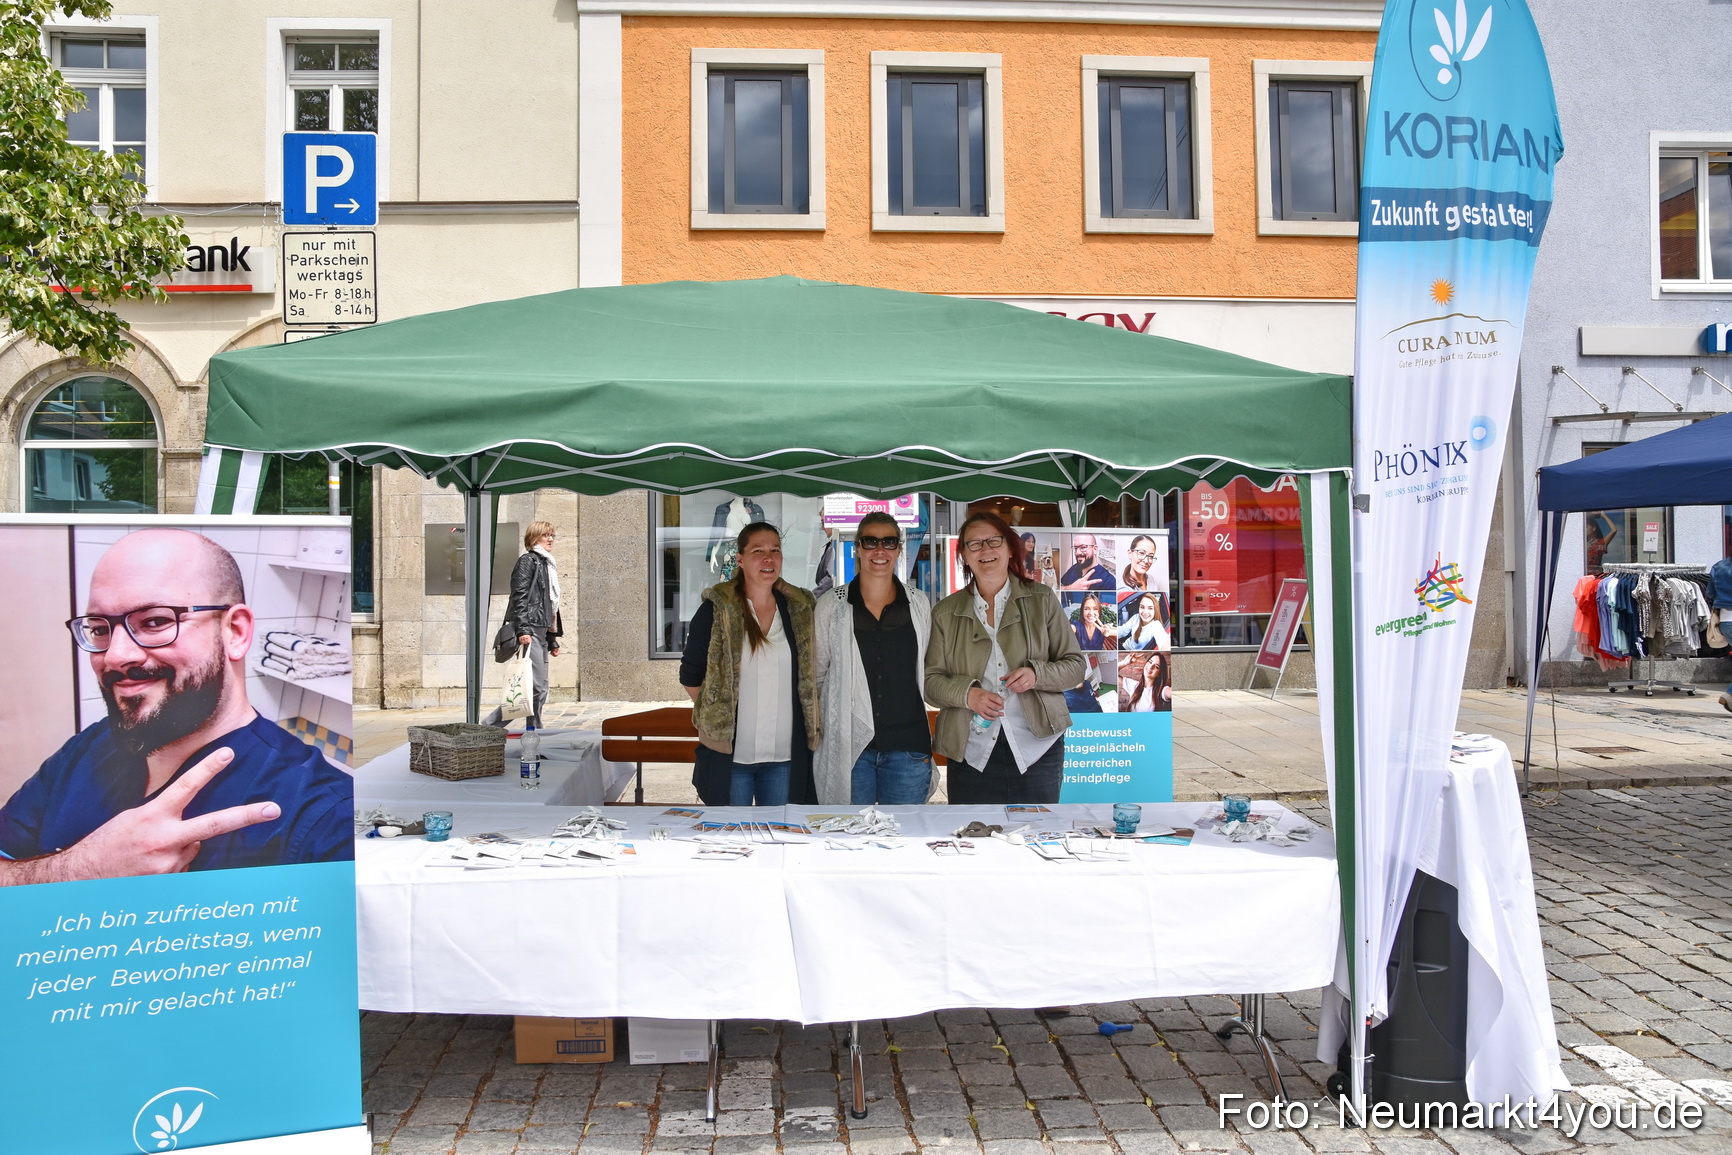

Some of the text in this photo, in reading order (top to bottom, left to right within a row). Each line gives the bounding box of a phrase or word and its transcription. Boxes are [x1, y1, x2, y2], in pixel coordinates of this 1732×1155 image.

[1384, 110, 1550, 175] KORIAN
[305, 145, 355, 214] P
[1371, 199, 1440, 226] Zukunft
[302, 238, 356, 251] nur mit
[290, 253, 369, 266] Parkschein
[297, 269, 363, 284] werktags
[289, 288, 328, 300] Mo-Fr
[290, 305, 305, 316] Sa
[1398, 330, 1499, 354] CURANUM
[1440, 352, 1455, 364] hat
[1374, 440, 1469, 482] PHÖNIX
[1192, 500, 1228, 520] -50
[1209, 591, 1231, 601] say
[1063, 727, 1133, 738] lbstbewusst
[1063, 742, 1146, 755] ntageinlächeln
[1062, 757, 1132, 768] eleerreichen
[1063, 773, 1131, 784] irsindpflege
[99, 909, 137, 929] bin
[144, 901, 255, 925] zufrieden
[261, 896, 300, 915] mit
[16, 926, 322, 967] meinem Arbeitstag, wenn
[26, 950, 313, 1000] jeder Bewohner einmal
[51, 1002, 94, 1024] mit
[100, 997, 142, 1017] mir
[147, 988, 236, 1016] gelacht
